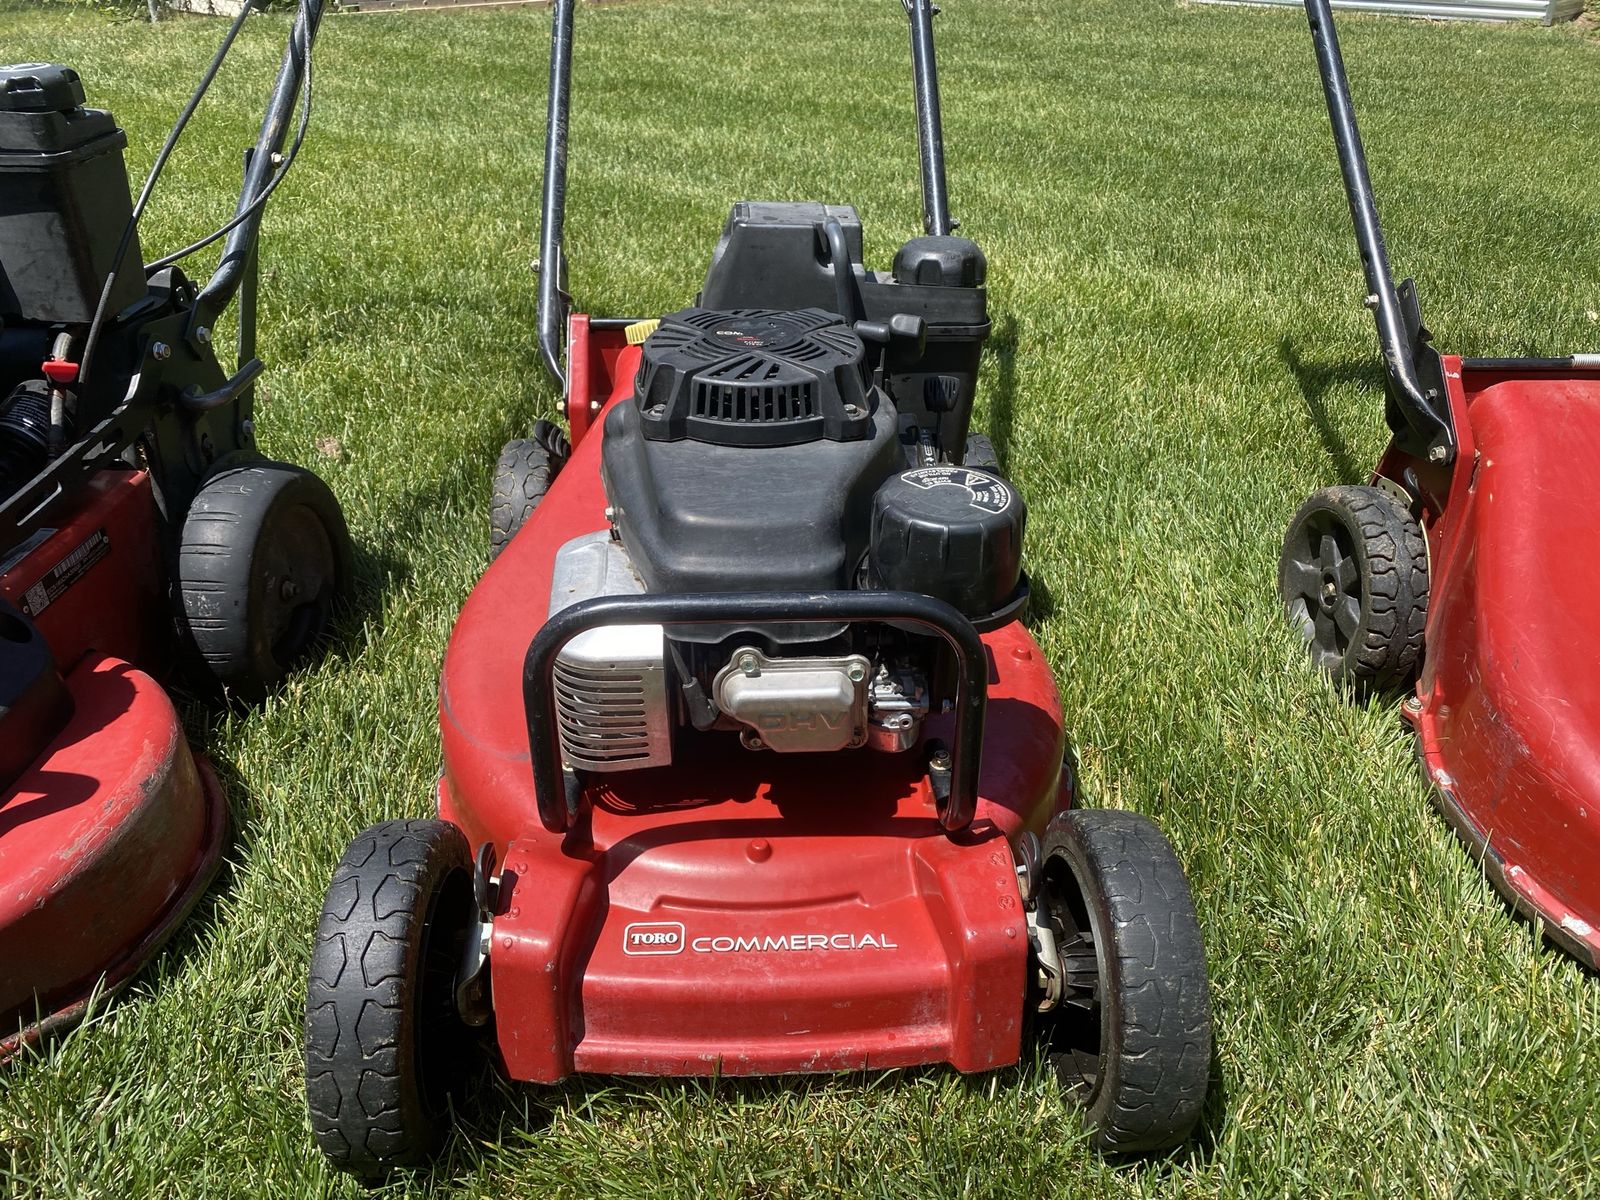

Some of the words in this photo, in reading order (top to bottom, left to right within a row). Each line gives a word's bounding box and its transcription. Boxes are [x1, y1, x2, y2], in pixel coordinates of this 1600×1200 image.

[759, 711, 848, 732] OHV
[631, 932, 678, 946] TORO
[691, 933, 899, 953] COMMERCIAL
